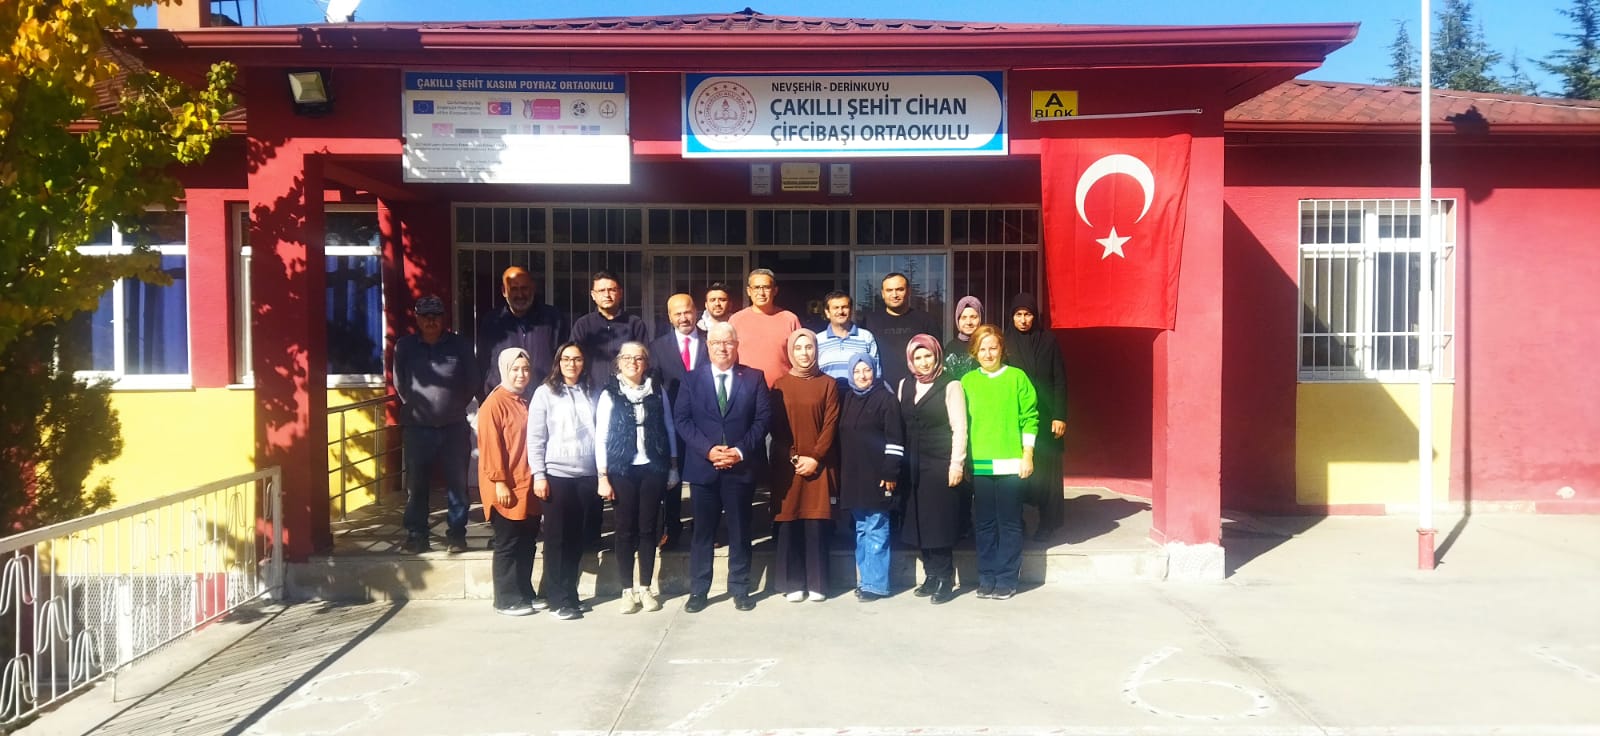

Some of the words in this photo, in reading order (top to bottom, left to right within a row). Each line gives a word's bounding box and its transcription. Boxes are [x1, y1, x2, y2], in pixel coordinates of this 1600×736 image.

[416, 78, 453, 90] ÇAKILLI
[456, 77, 484, 91] ŞEHİT
[487, 79, 517, 89] KASIM
[520, 80, 557, 90] POYRAZ
[560, 80, 615, 91] ORTAOKULU
[771, 79, 822, 94] NEVŞEHİR
[829, 79, 890, 93] DERİNKUYU
[770, 97, 842, 120] ÇAKILLI
[847, 94, 902, 120] ŞEHİT
[905, 94, 967, 116] CİHAN
[1044, 92, 1065, 108] A
[770, 121, 855, 146] ÇİFCİBAŞI
[860, 124, 970, 142] ORTAOKULU
[668, 657, 780, 732] 7
[1121, 646, 1272, 720] 6
